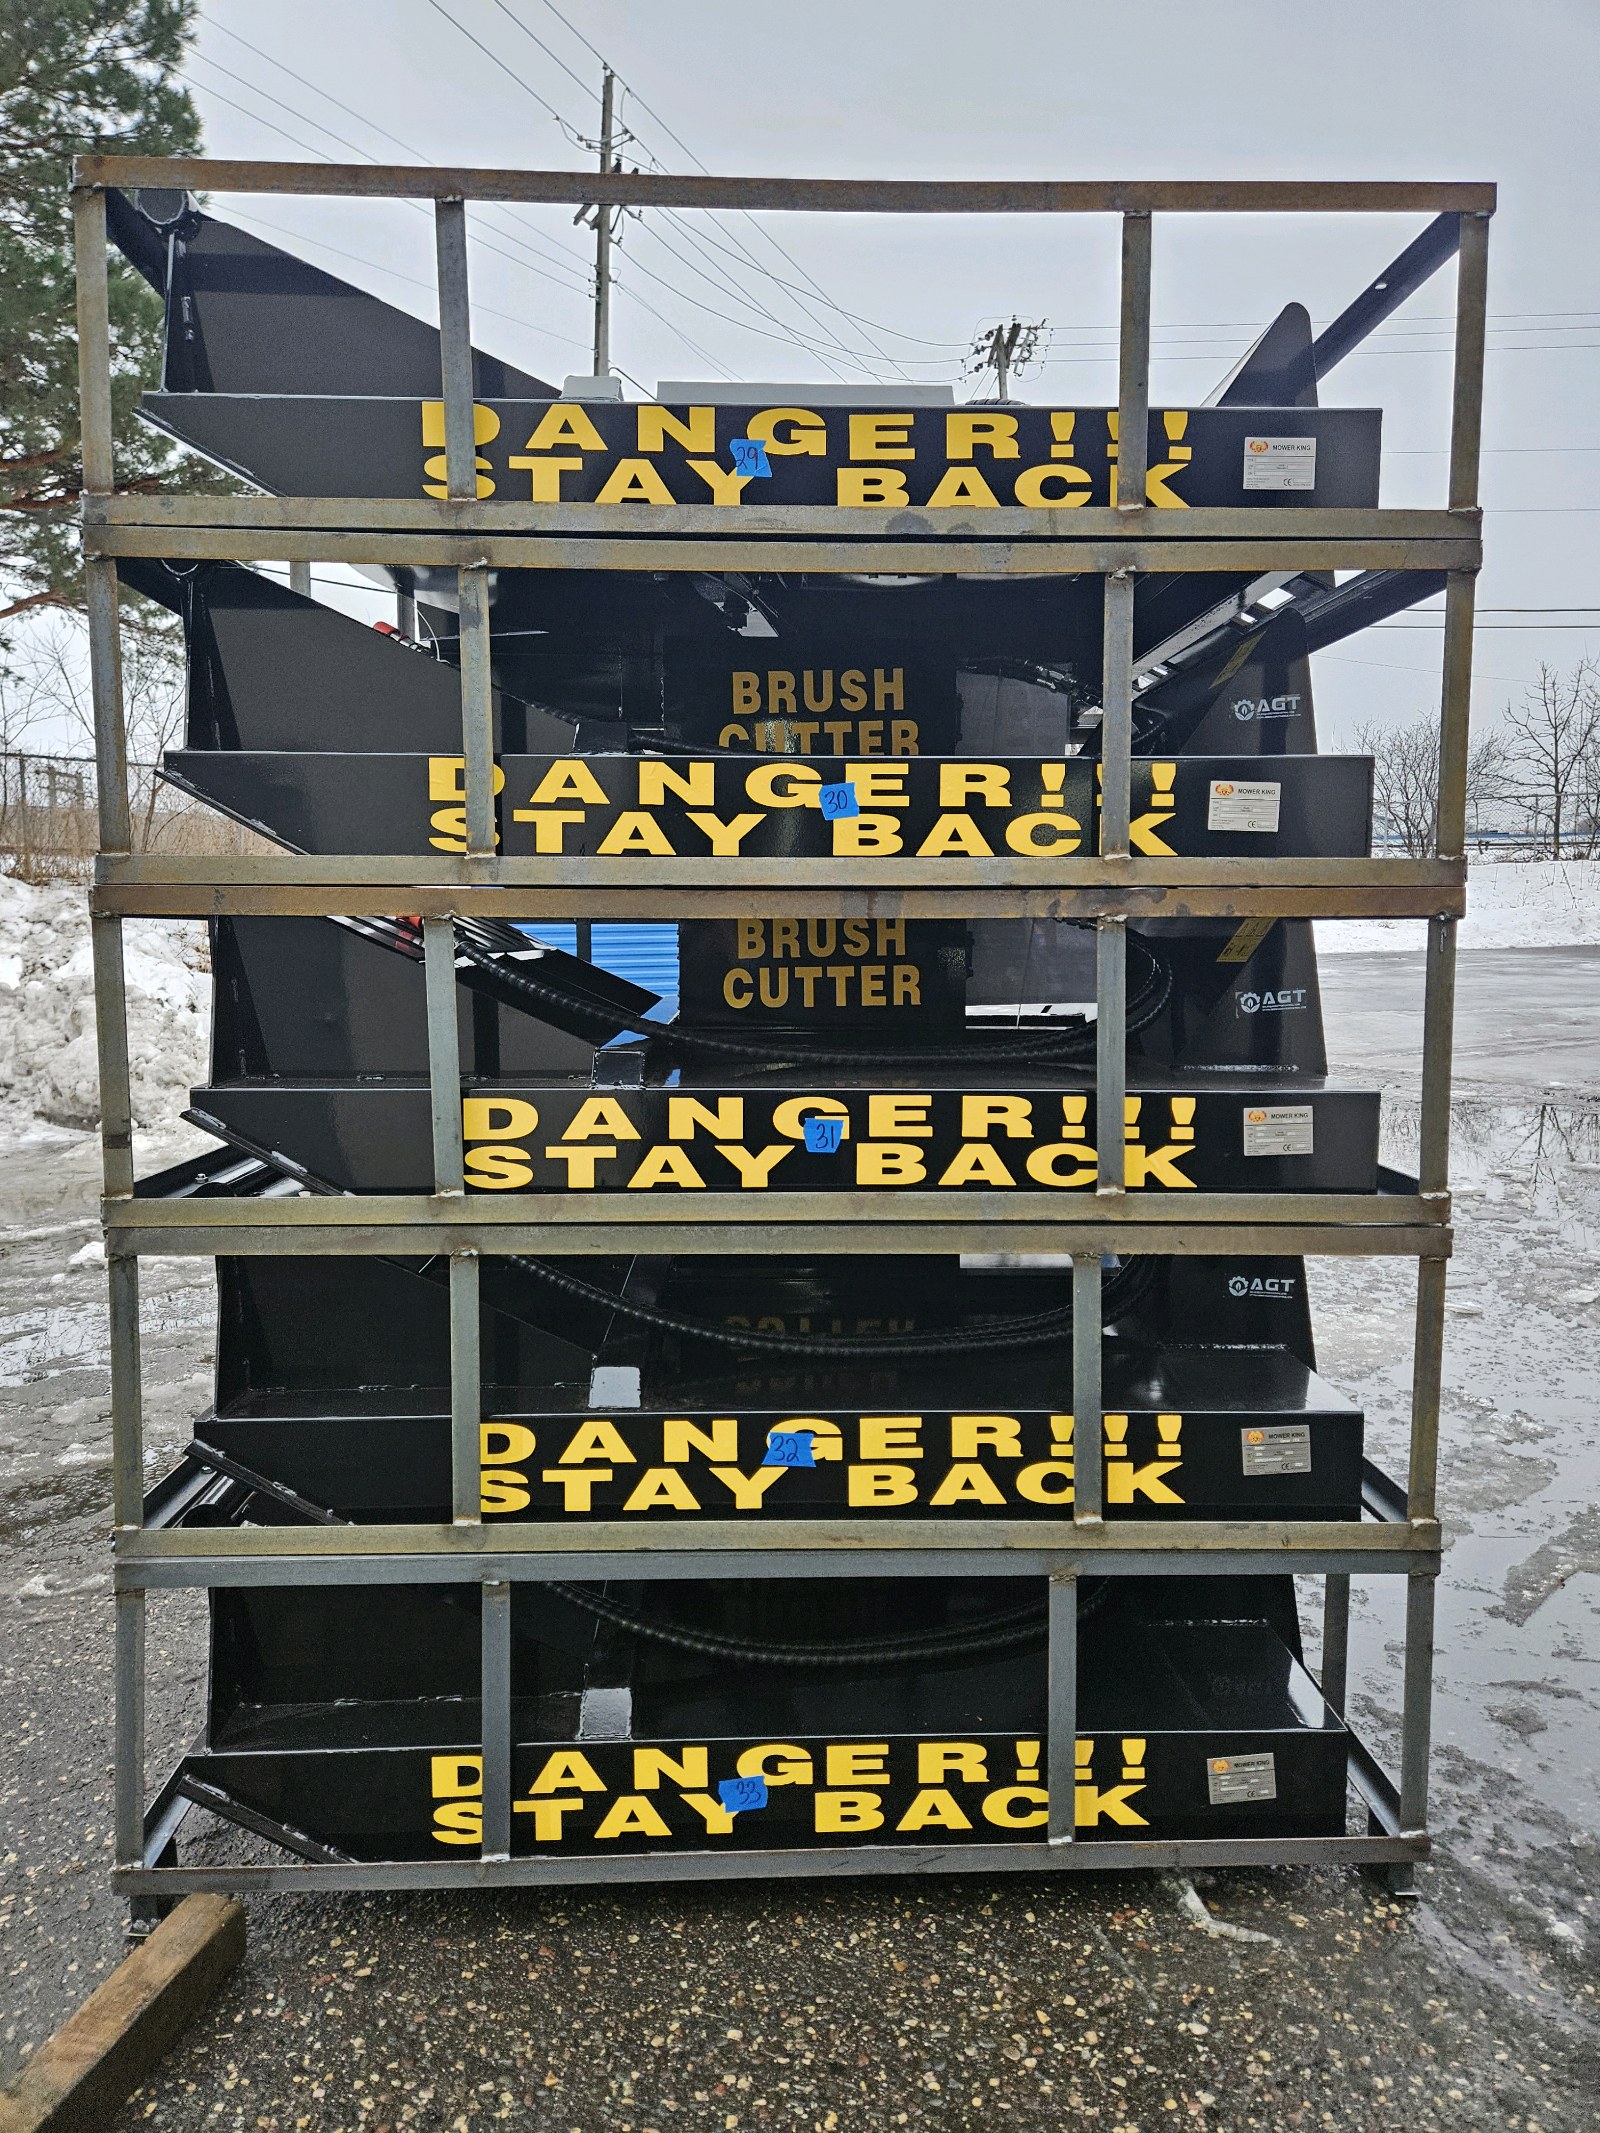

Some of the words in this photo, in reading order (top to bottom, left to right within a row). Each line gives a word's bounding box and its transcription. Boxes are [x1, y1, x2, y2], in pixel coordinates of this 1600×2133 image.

[736, 446, 758, 469] 29
[422, 454, 756, 506] STAY
[837, 463, 1191, 508] BACK
[732, 668, 904, 714] BRUSH
[1256, 697, 1301, 712] AGT
[719, 719, 919, 755] CUTTER
[429, 758, 1176, 807] DANGER!!
[825, 790, 847, 813] 30
[429, 807, 767, 856] STAY
[833, 812, 1178, 857] BACK
[738, 918, 905, 958] BRUSH
[723, 965, 921, 1008] CUTTER
[1263, 989, 1306, 1005] AGT
[463, 1095, 1196, 1140] DANGER!!!
[816, 1123, 834, 1149] 31
[463, 1144, 795, 1189] STAY
[857, 1143, 1197, 1187] BACK
[1250, 1278, 1296, 1292] AGT
[480, 1416, 1182, 1464] DANGER!!!
[771, 1435, 799, 1462] 32
[480, 1466, 788, 1512] STAY
[848, 1461, 1186, 1507] BACK
[432, 1739, 1146, 1797] DANGER!!!
[737, 1781, 761, 1804] 33
[432, 1793, 741, 1844] STAY
[814, 1785, 1150, 1832] BACK
